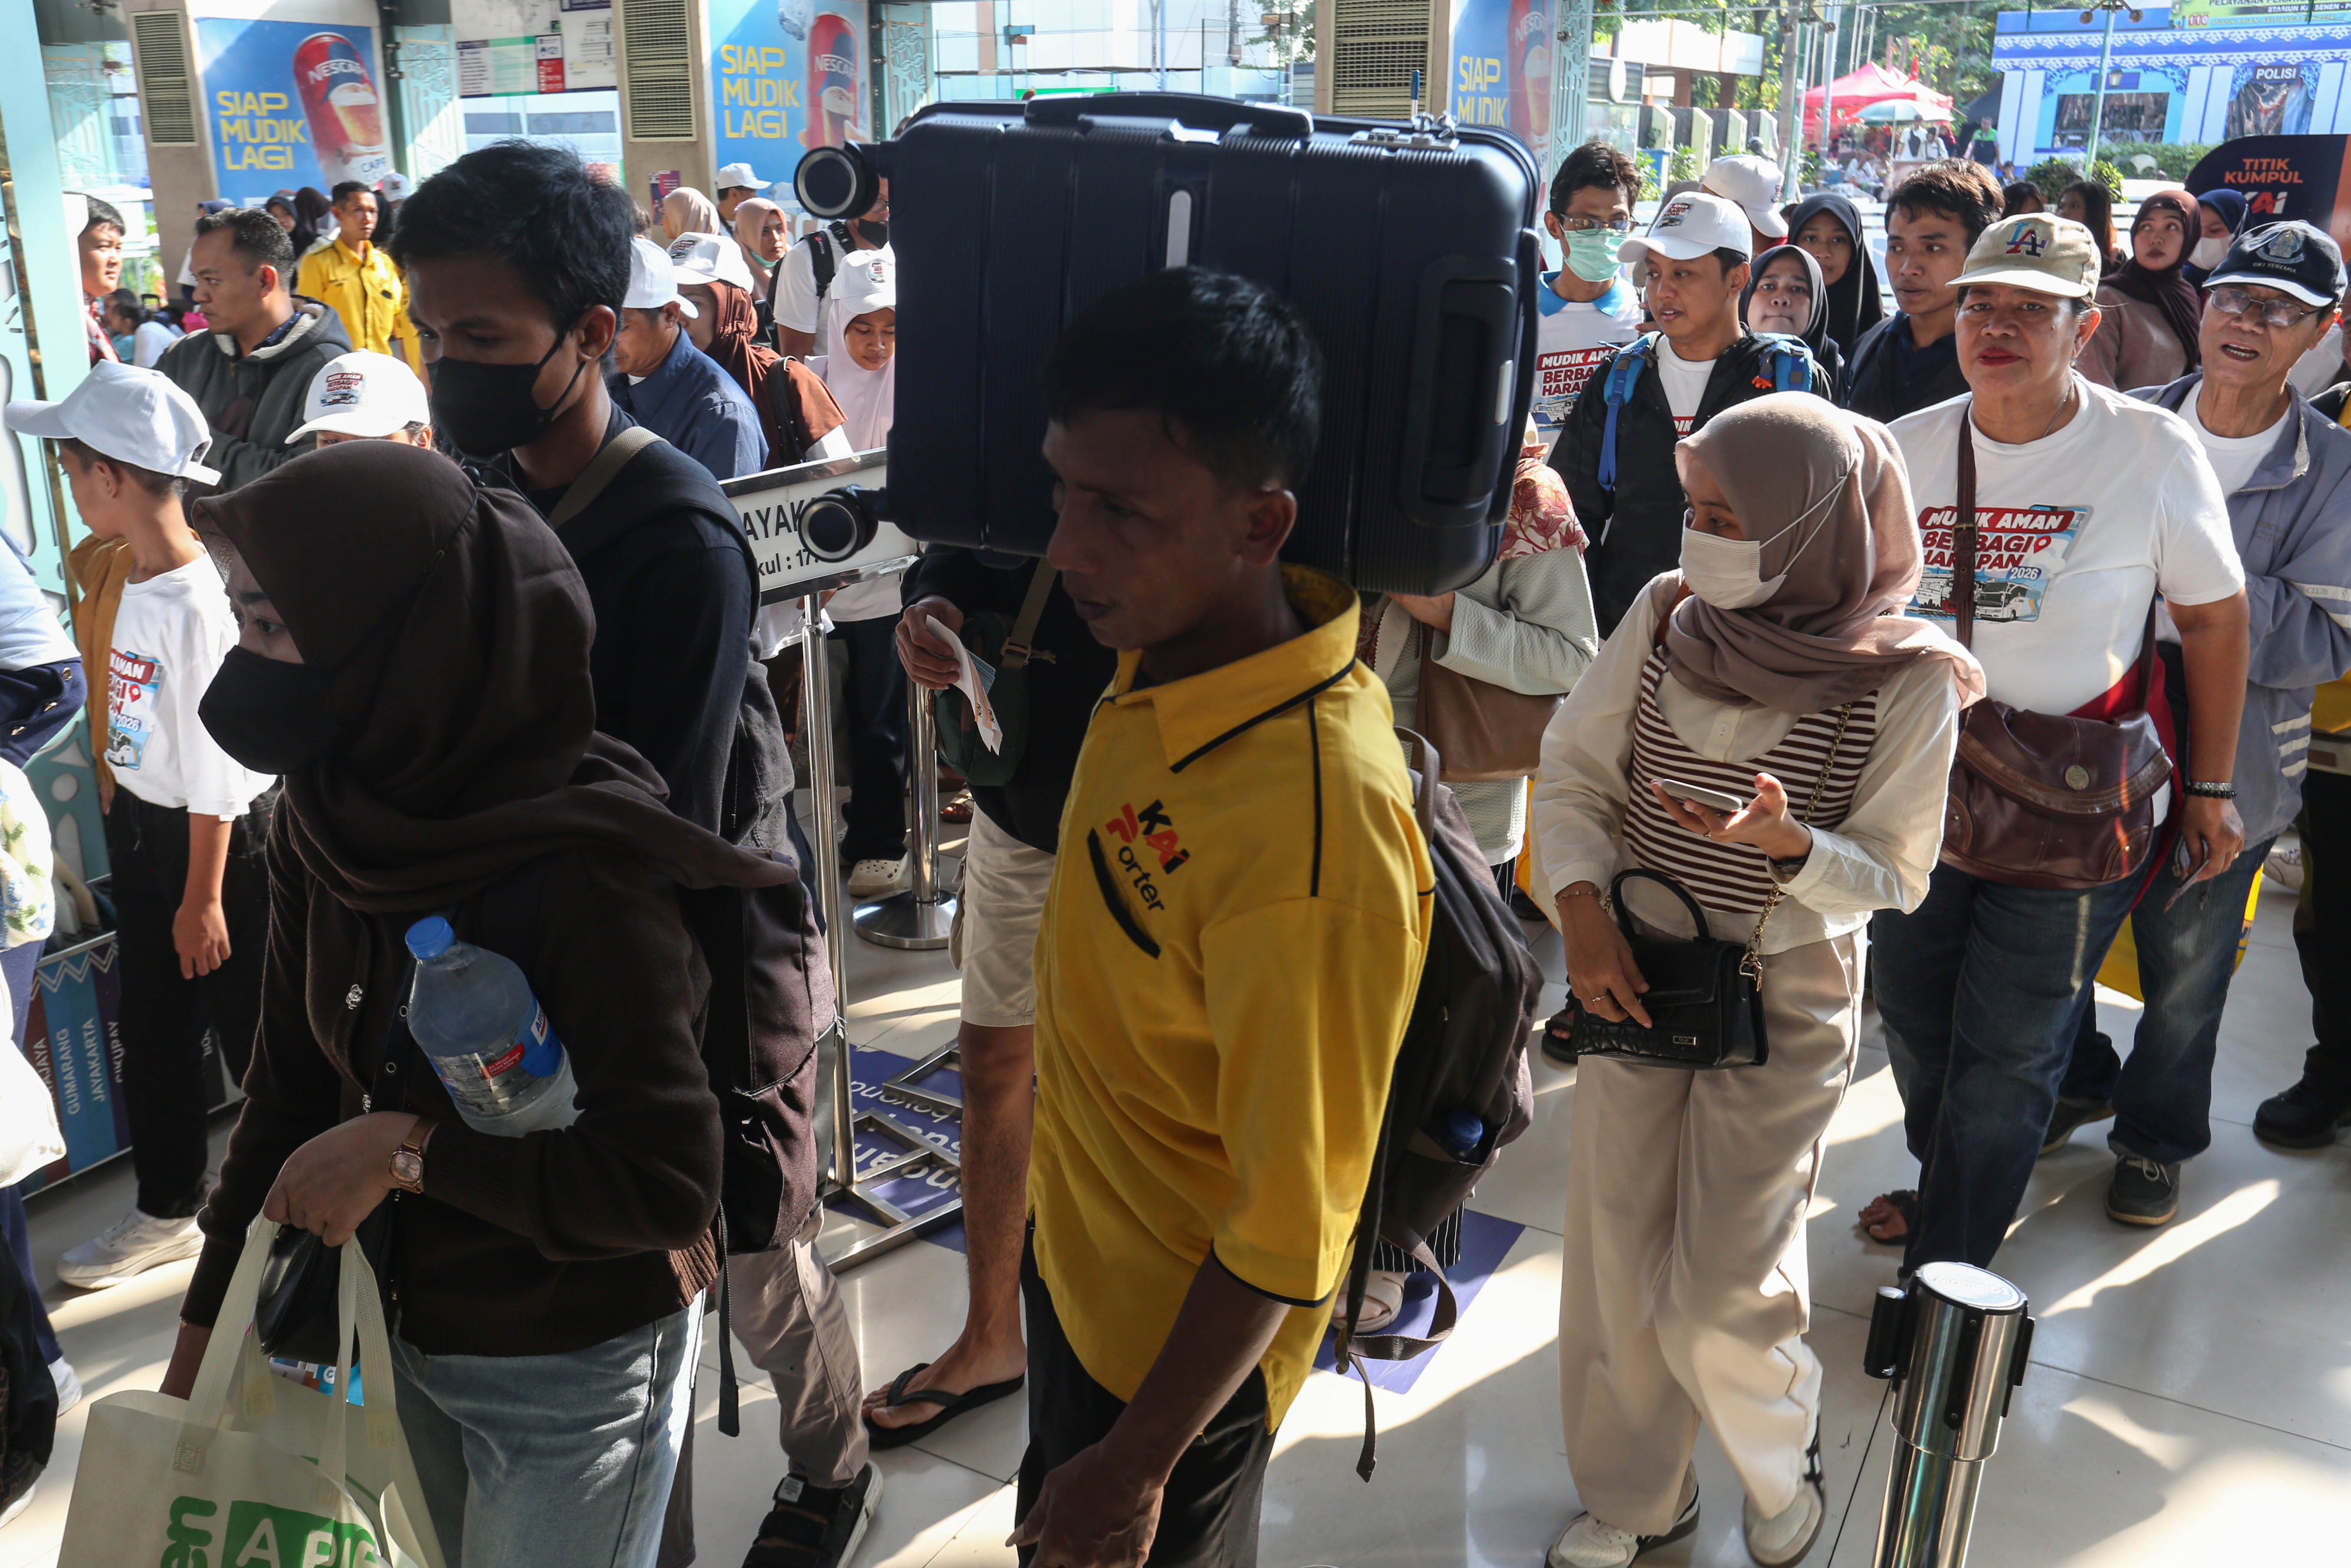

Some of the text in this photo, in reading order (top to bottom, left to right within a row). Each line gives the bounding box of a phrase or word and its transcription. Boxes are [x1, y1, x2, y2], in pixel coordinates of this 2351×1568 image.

[2188, 14, 2209, 25] 110
[721, 44, 786, 75] SIAP
[1458, 55, 1501, 92] SIAP
[2256, 68, 2297, 80] POLISI
[217, 90, 289, 116] SIAP
[722, 77, 800, 108] MUDIK
[220, 118, 307, 144] MUDIK
[724, 109, 788, 138] LAGI
[223, 145, 295, 170] LAGI
[2242, 158, 2290, 171] TITIK
[2224, 171, 2303, 184] KUMPUL
[1542, 352, 1585, 368] MUDIK
[1543, 366, 1595, 385] BERBA
[1996, 512, 2065, 531] AMAN
[2009, 568, 2039, 580] 2026
[115, 715, 140, 732] 2026
[1137, 799, 1190, 875] KAI
[56, 1028, 81, 1115] GUMARANG
[82, 1018, 106, 1102] JAYAKARTA
